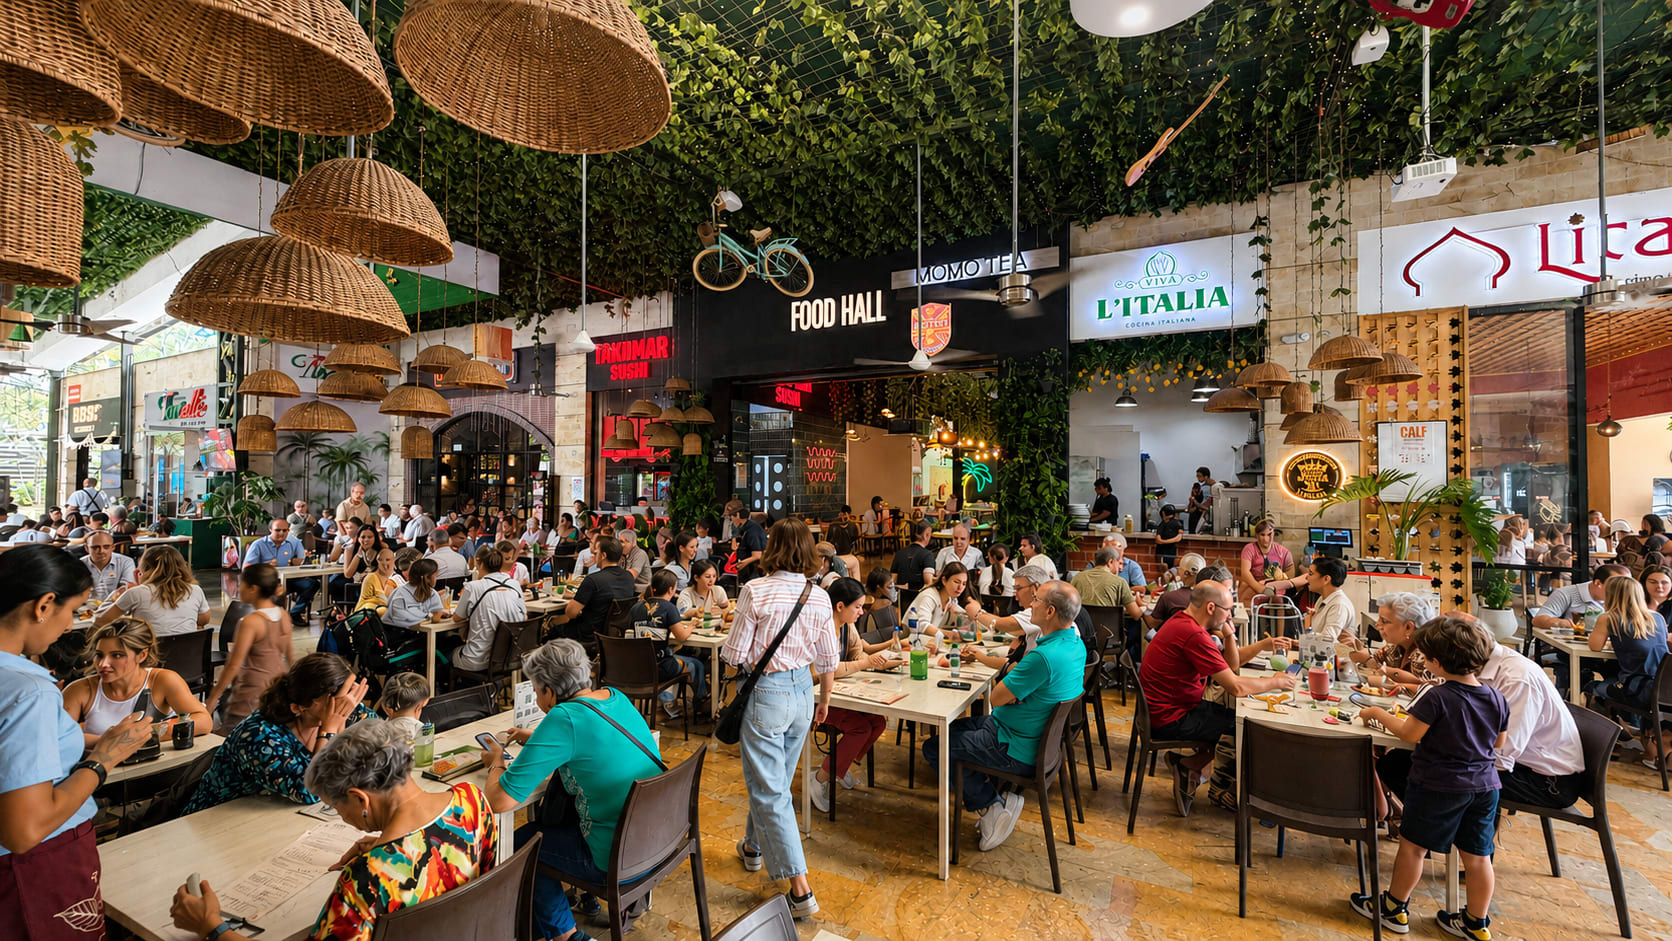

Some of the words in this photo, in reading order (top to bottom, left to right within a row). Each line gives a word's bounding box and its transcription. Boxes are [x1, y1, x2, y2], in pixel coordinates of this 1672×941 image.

[915, 259, 980, 284] MOMO
[985, 251, 1028, 275] TEA
[1145, 275, 1177, 286] VIVA
[791, 297, 836, 332] FOOD
[841, 289, 887, 326] HALL
[1158, 316, 1196, 326] ITALIANA
[610, 361, 649, 381] SUSHI
